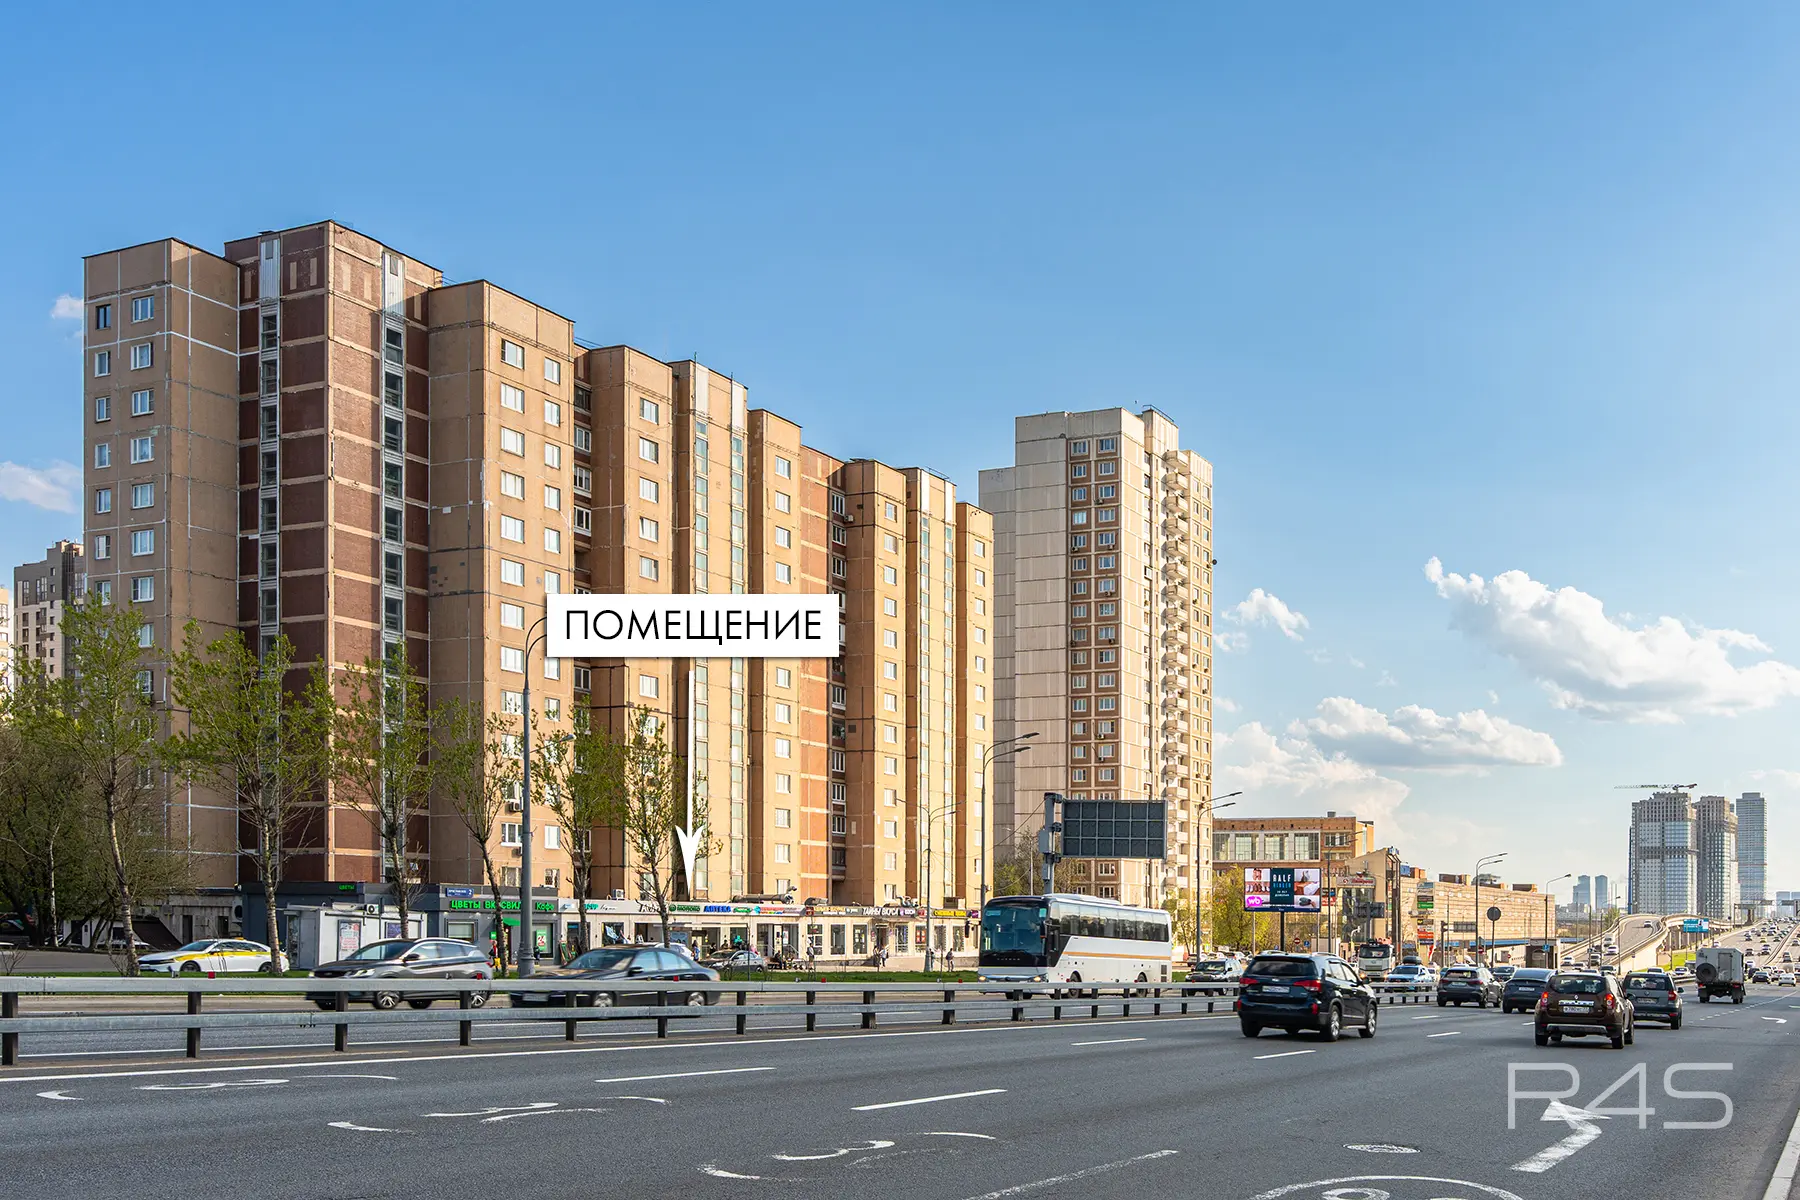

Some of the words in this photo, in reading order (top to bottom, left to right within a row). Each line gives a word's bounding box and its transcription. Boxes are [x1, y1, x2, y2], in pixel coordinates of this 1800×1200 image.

[1272, 874, 1291, 882] RALF
[451, 900, 481, 910] ЦВЕТЫ
[703, 905, 732, 913] АПТЕКА
